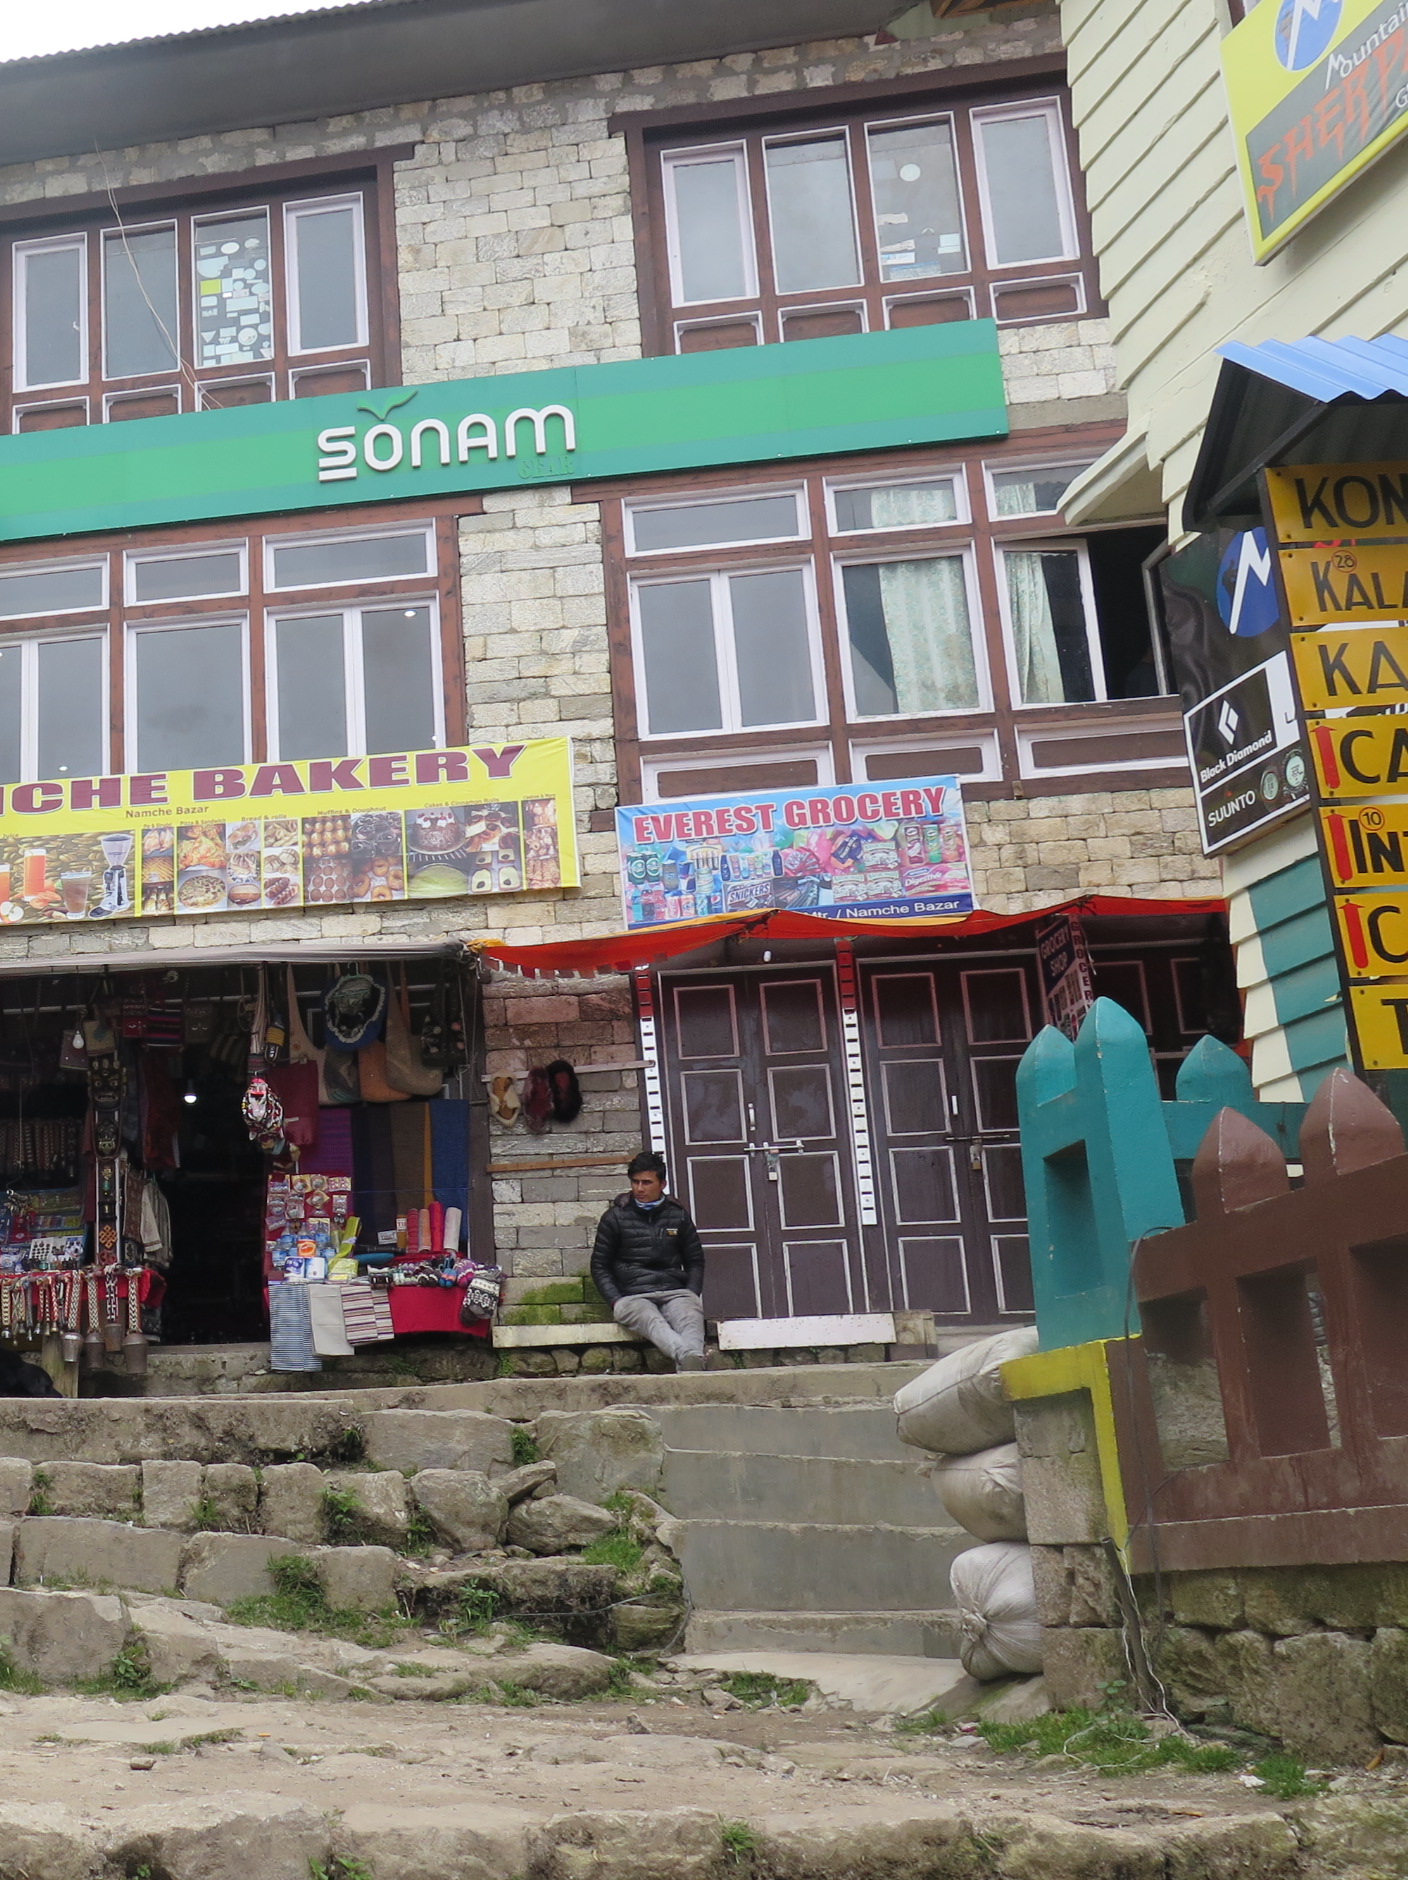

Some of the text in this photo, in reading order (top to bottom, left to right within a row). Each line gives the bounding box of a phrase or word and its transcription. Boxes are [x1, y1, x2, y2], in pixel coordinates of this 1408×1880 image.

[1325, 2, 1408, 90] Mountai
[1256, 22, 1408, 223] SHERP
[1335, 554, 1355, 569] 28
[1311, 560, 1408, 612] KAL
[192, 743, 528, 802] BAKERY
[1200, 730, 1273, 784] Black Diamond
[125, 805, 210, 819] Namche Bazar
[352, 806, 387, 814] Doughnut
[632, 786, 947, 844] EVEREST GROCERY
[1208, 790, 1256, 827] SUUNTO
[1363, 811, 1382, 826] 10
[1349, 819, 1408, 873] IN
[729, 884, 770, 903] SNICKERS
[846, 905, 910, 919] Namche
[914, 899, 960, 913] Bazar
[1050, 951, 1068, 977] SHOP
[1070, 921, 1095, 1008] GROCER
